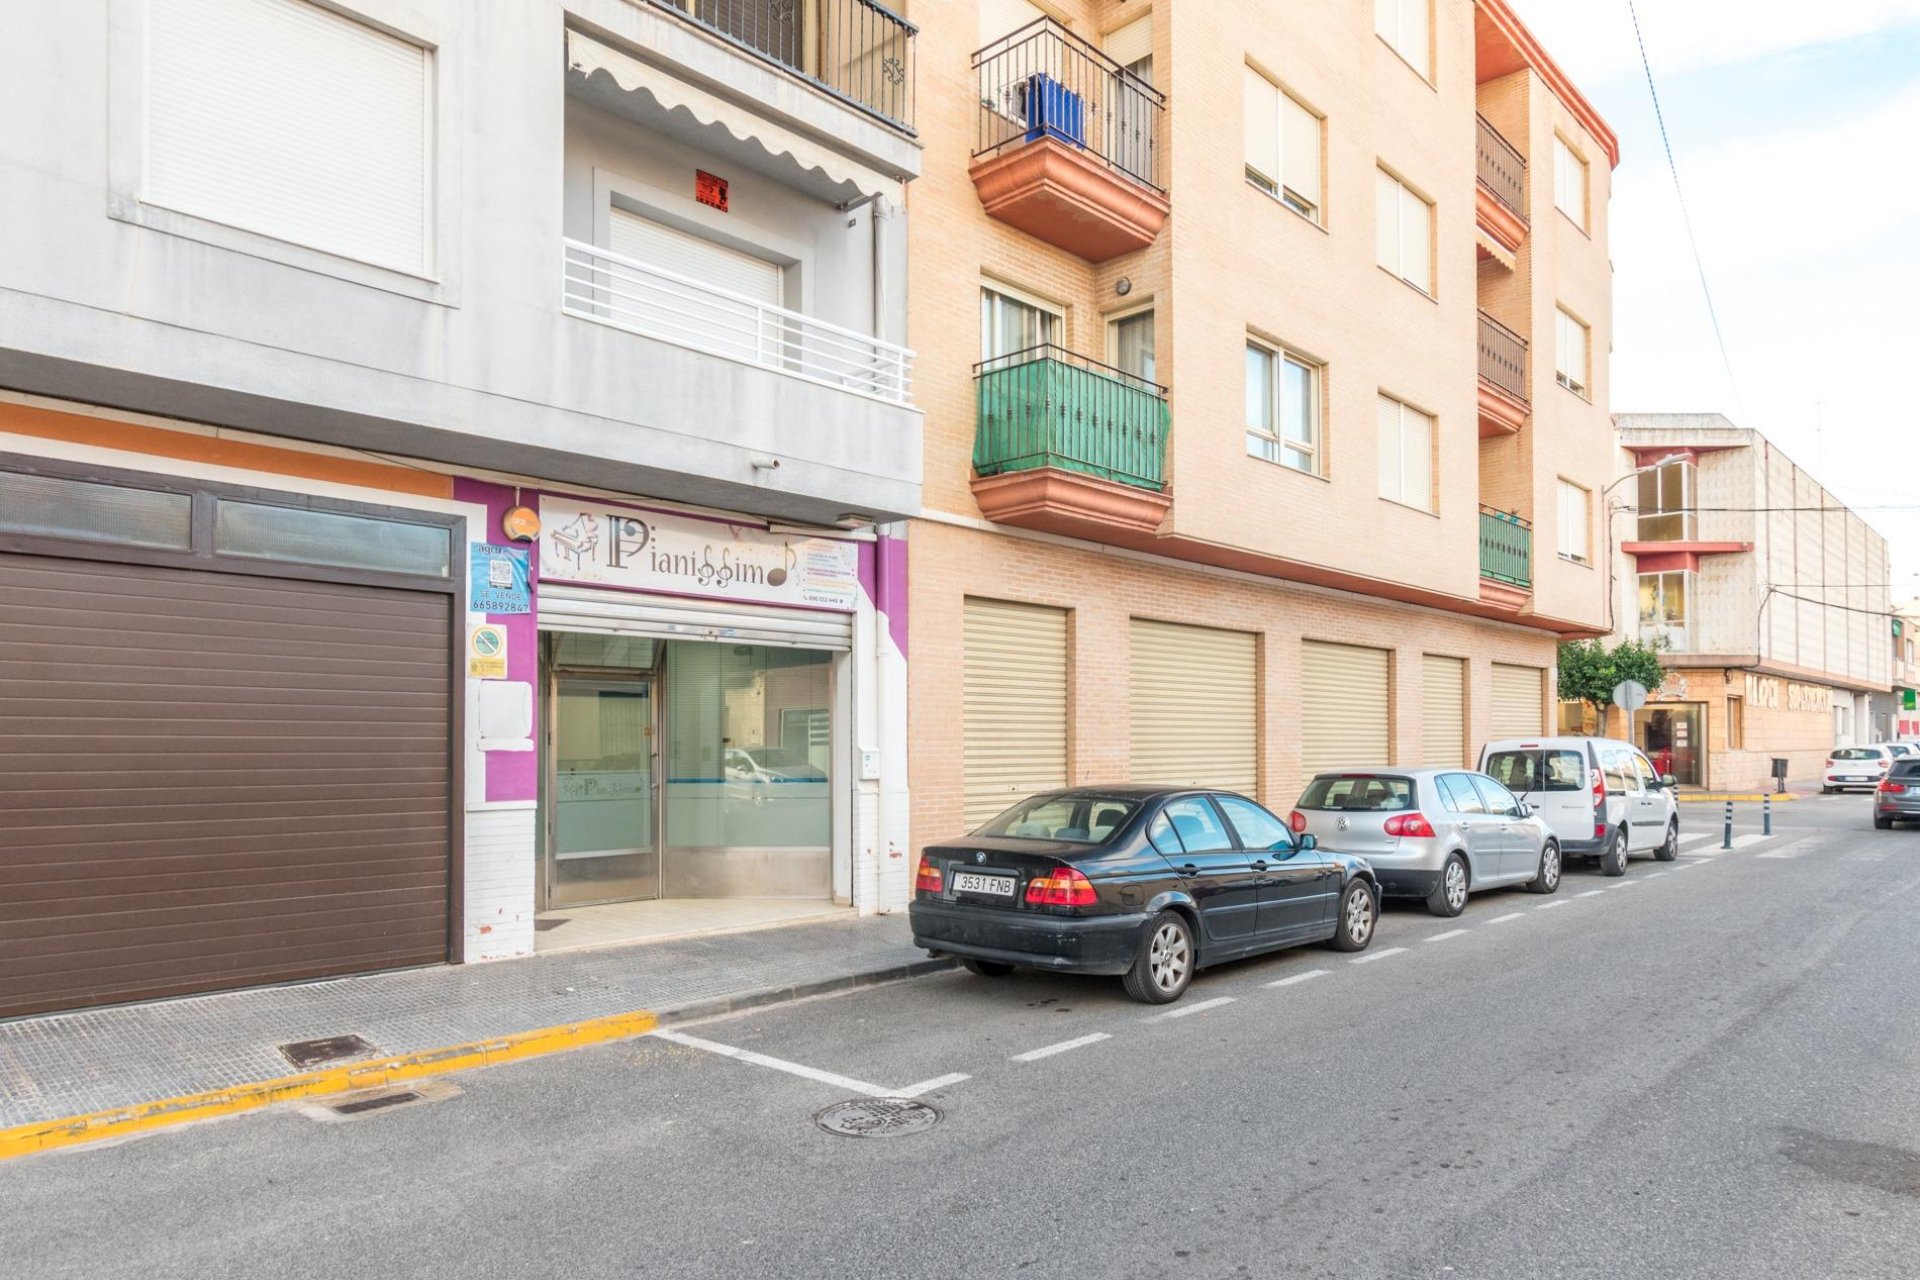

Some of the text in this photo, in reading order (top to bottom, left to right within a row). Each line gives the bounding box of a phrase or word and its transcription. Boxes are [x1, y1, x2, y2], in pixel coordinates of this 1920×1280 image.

[495, 592, 521, 601] VENDE
[961, 875, 1012, 893] 3531 FNB
